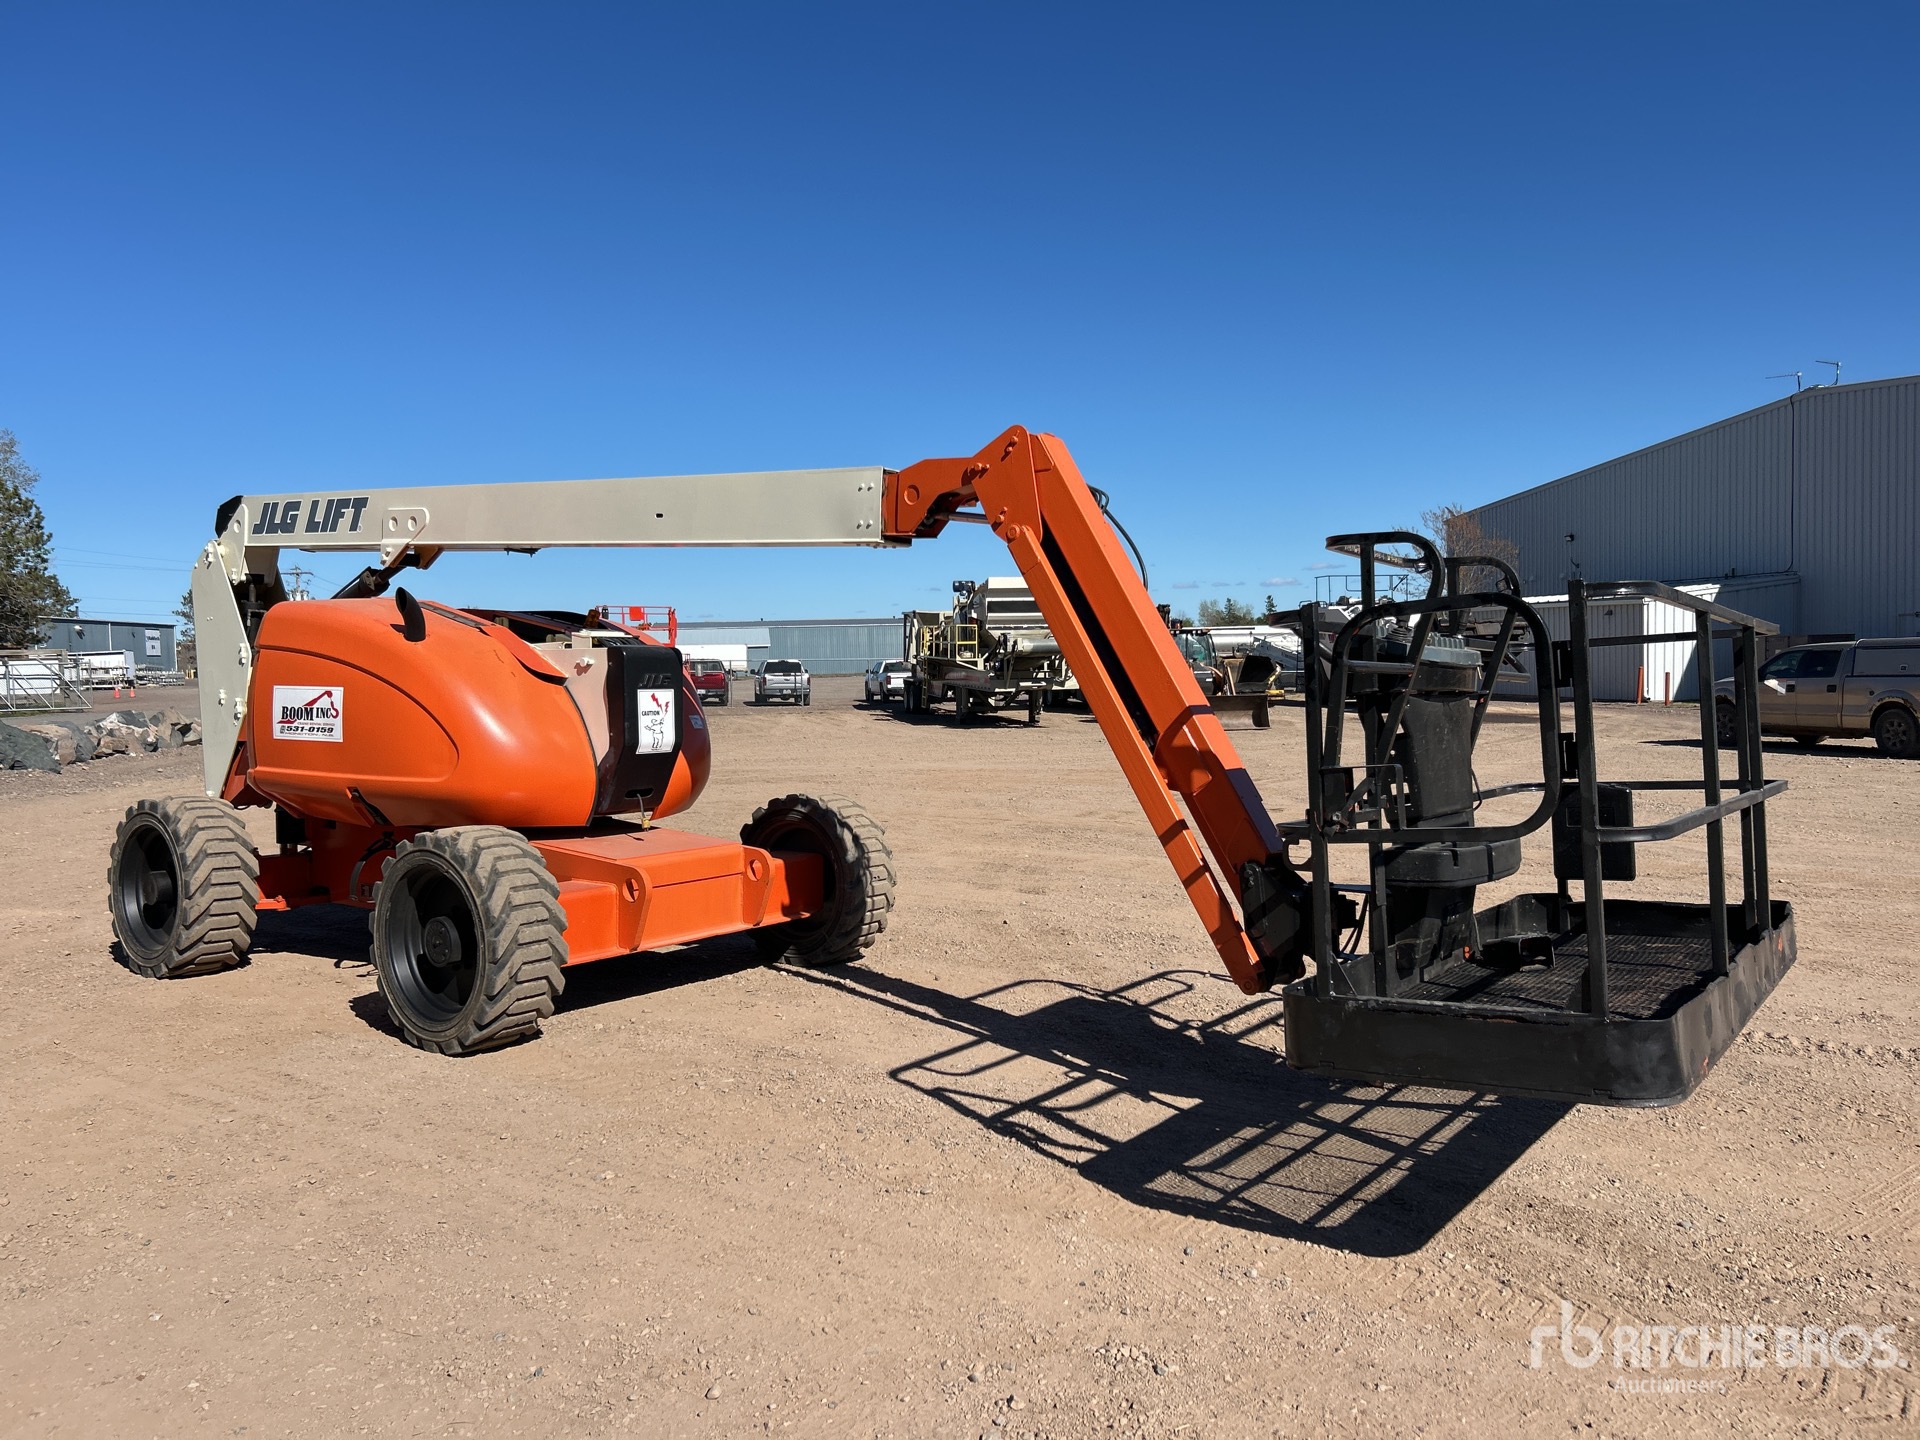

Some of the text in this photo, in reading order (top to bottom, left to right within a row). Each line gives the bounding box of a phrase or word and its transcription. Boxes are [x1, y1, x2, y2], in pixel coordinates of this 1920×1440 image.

[251, 496, 370, 536] JLG LIFT
[281, 706, 332, 720] BOOM INC
[286, 725, 334, 733] 531-0159
